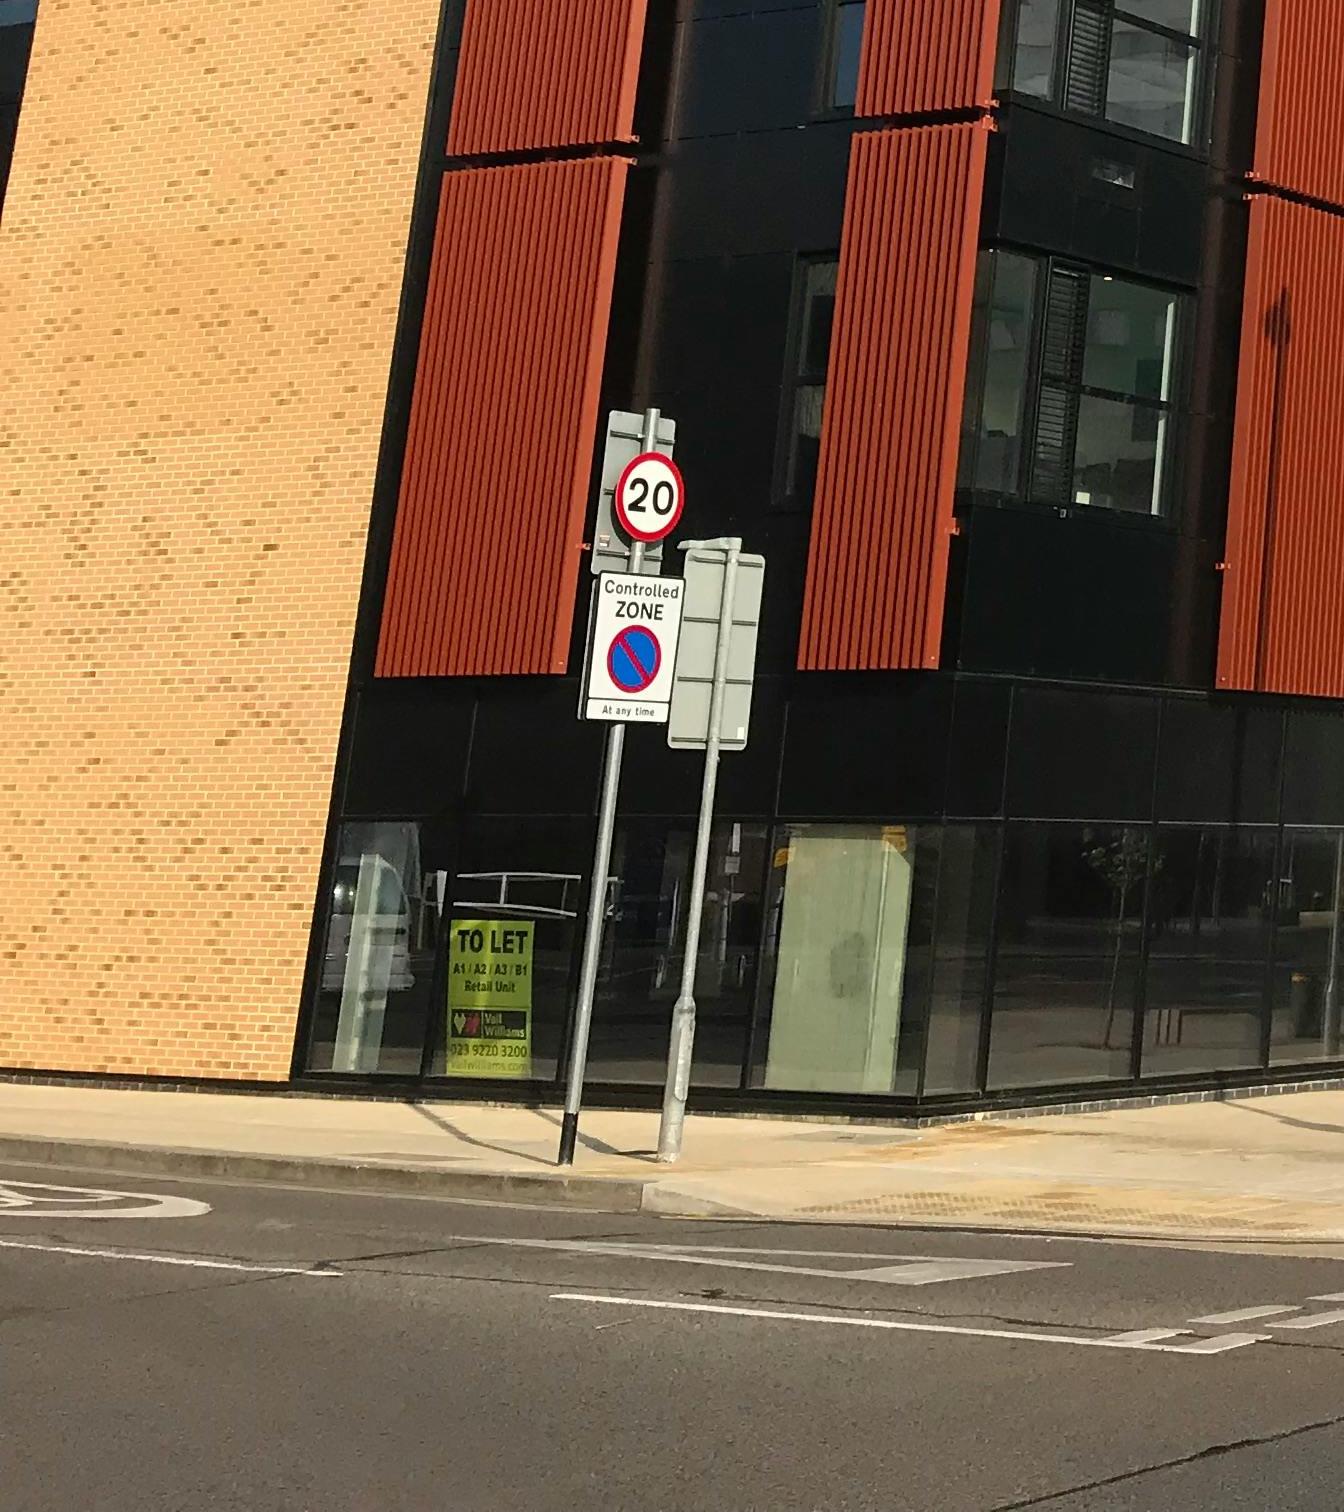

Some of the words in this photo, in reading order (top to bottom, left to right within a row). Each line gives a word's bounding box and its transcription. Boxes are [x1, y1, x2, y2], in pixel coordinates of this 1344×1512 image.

[628, 477, 674, 516] 20
[604, 579, 679, 599] Controlled
[615, 600, 664, 621] ZONE
[602, 704, 613, 715] At
[616, 706, 631, 717] any
[635, 705, 655, 716] time
[457, 929, 484, 954] TO
[490, 930, 528, 954] LET
[464, 979, 493, 993] Retail
[495, 980, 516, 994] Unit
[472, 1044, 498, 1057] 9220
[501, 1045, 528, 1058] 3200
